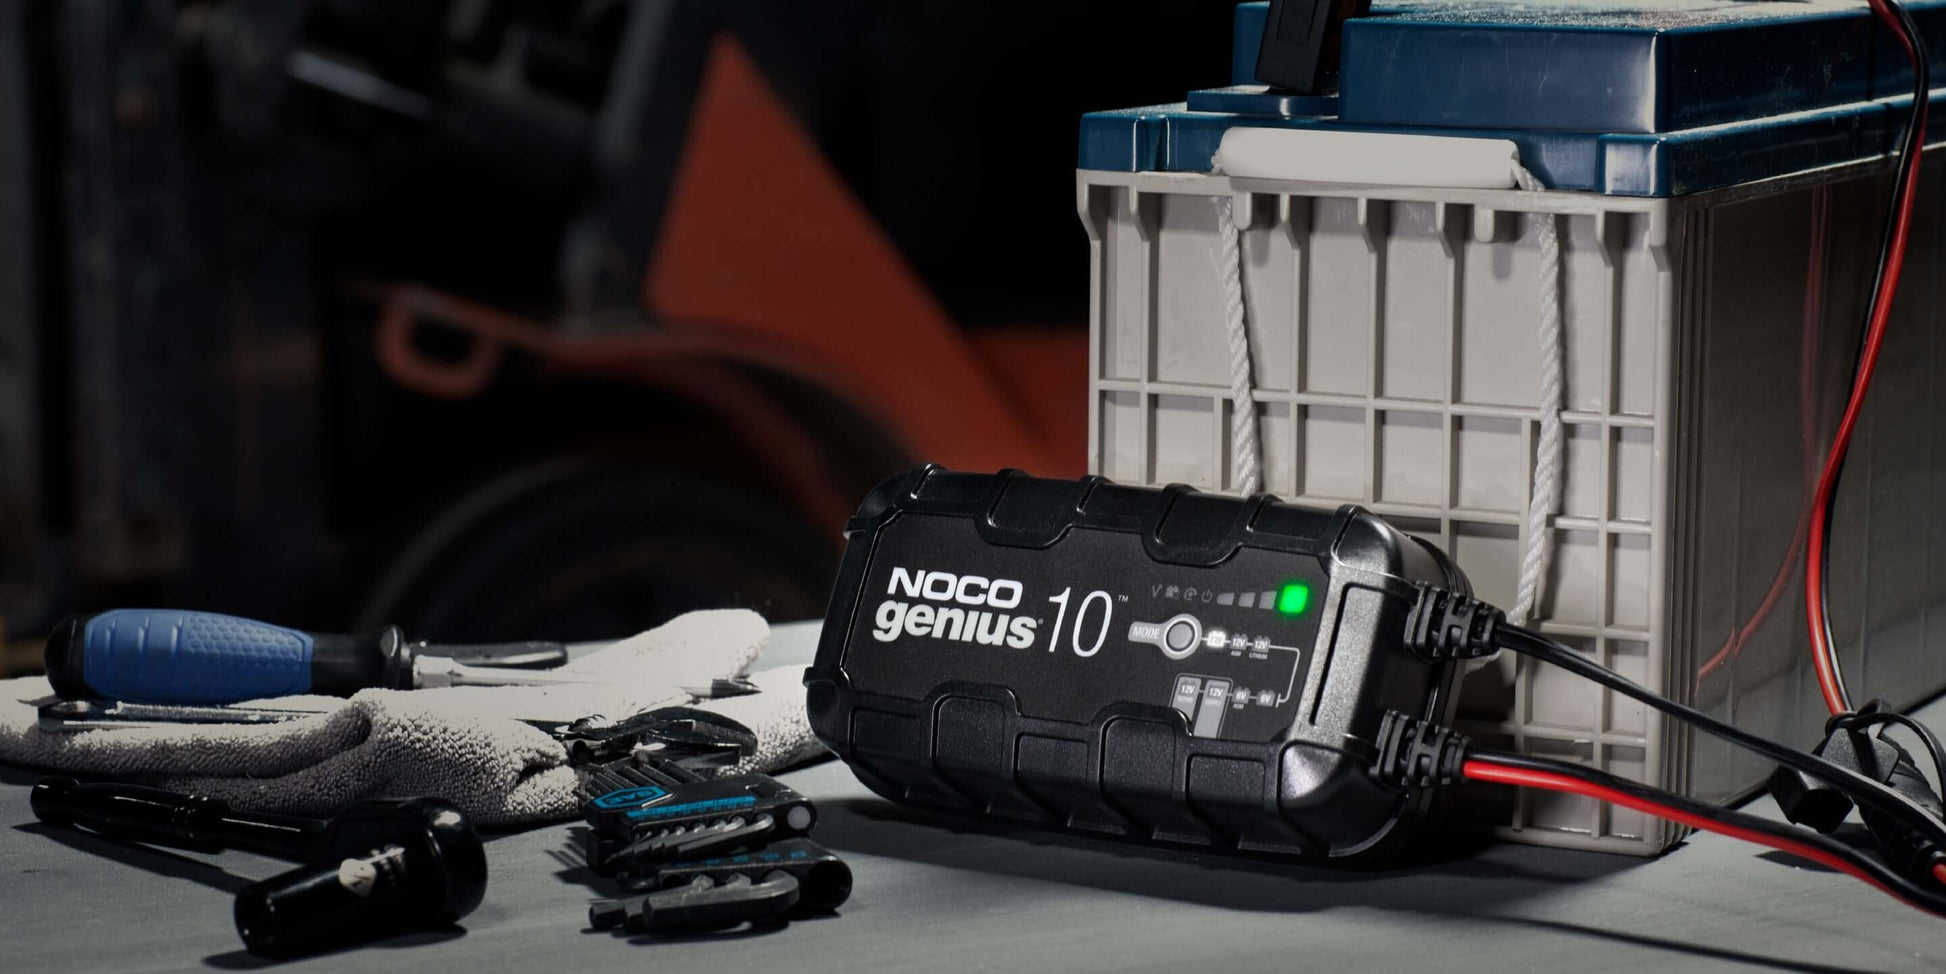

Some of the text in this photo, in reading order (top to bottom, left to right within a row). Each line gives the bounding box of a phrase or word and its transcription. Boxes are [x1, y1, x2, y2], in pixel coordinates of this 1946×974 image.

[887, 567, 1023, 609] NOCO
[872, 600, 1037, 649] genius
[1048, 587, 1113, 658] 10
[1132, 625, 1161, 639] MODE
[1232, 637, 1246, 648] 12V
[1254, 640, 1268, 650] 12V
[1181, 684, 1195, 695] 12V
[1209, 687, 1224, 697] 12V
[1236, 690, 1247, 700] 6V
